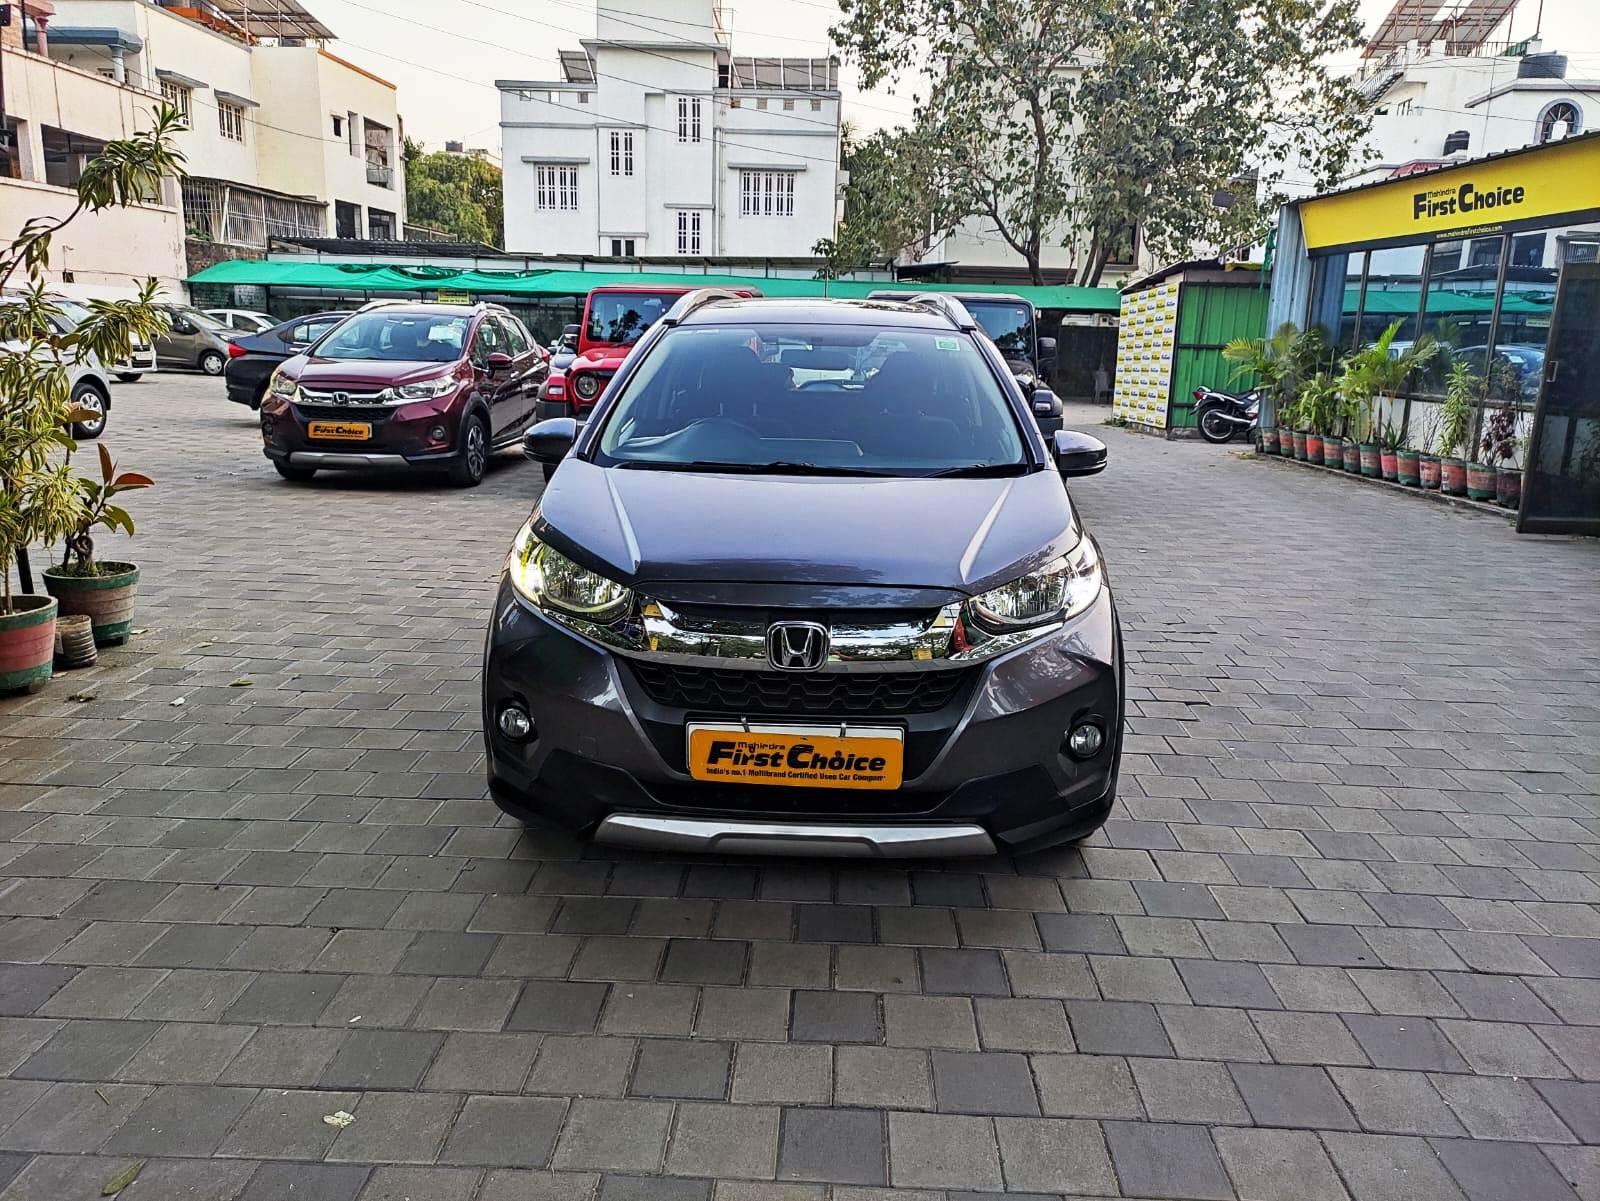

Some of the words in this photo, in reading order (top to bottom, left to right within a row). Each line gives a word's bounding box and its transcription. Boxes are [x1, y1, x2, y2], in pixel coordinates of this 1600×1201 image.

[1427, 188, 1456, 198] Mahindra
[1413, 193, 1456, 220] First
[1458, 183, 1524, 213] Choice
[738, 742, 786, 751] Mahindra
[706, 741, 785, 768] First
[786, 744, 886, 772] Choice
[706, 767, 730, 776] India's
[748, 769, 786, 778] Multibrand
[788, 771, 818, 780] Certified
[838, 773, 850, 781] Car
